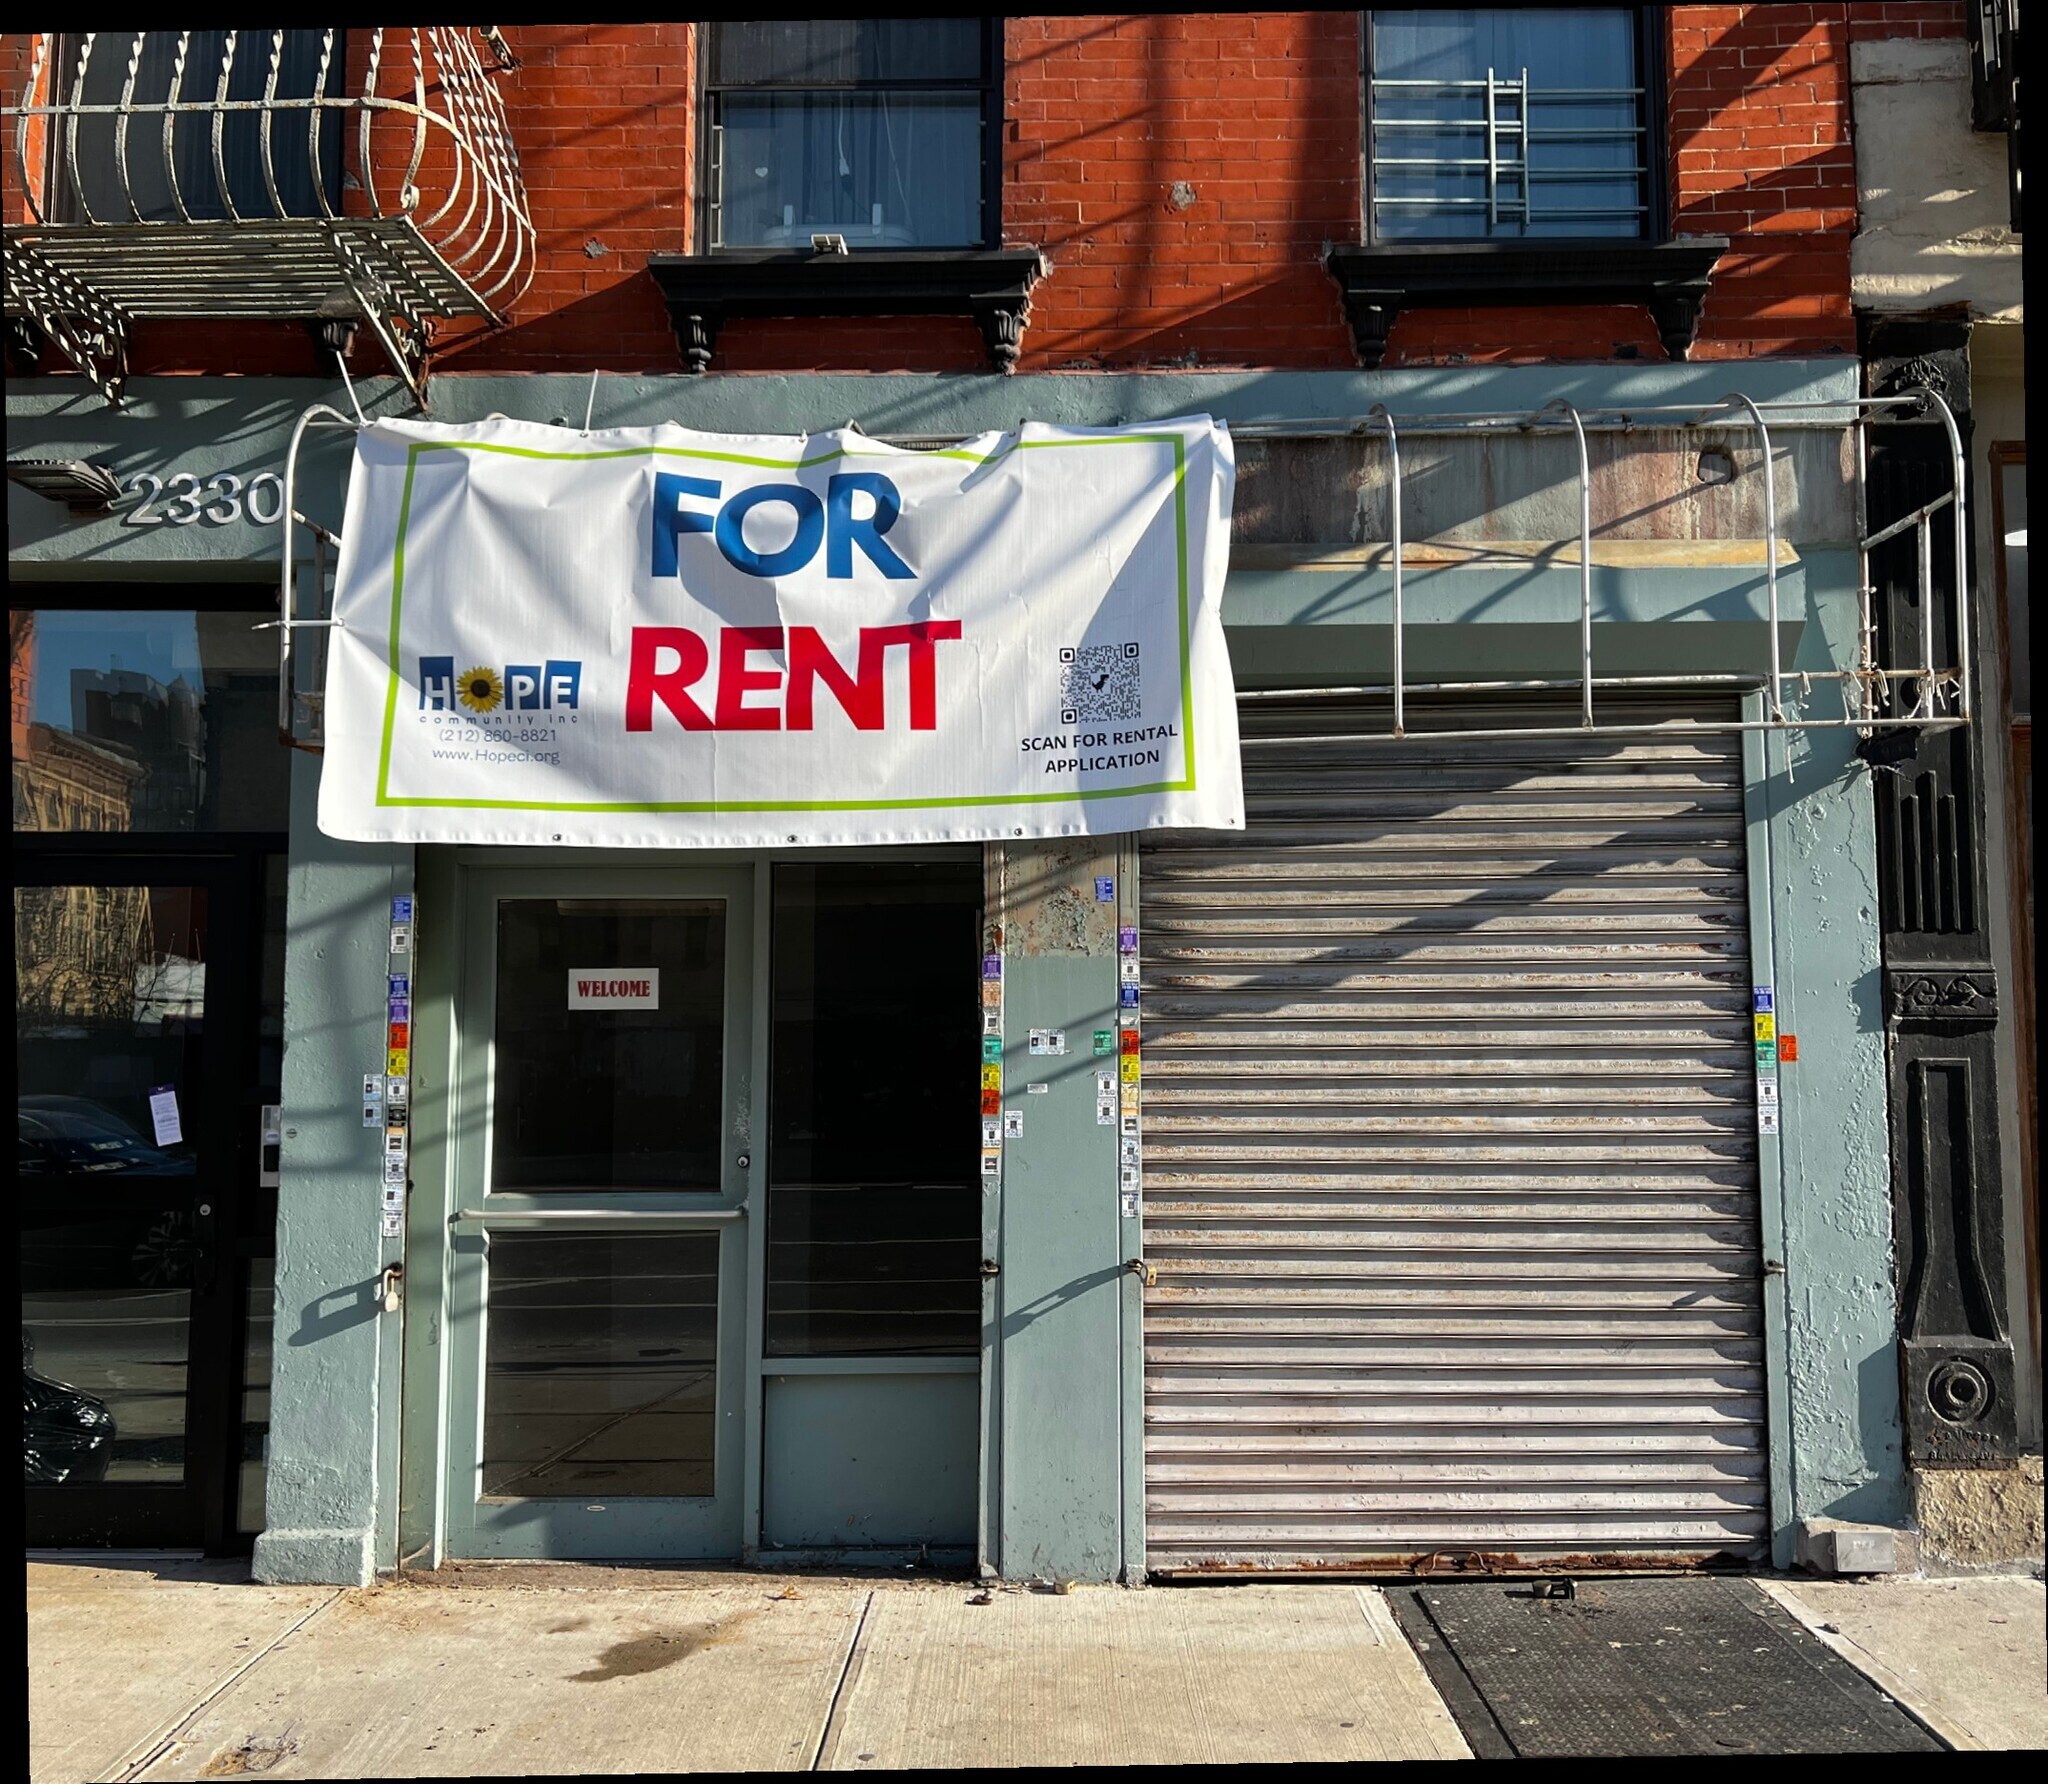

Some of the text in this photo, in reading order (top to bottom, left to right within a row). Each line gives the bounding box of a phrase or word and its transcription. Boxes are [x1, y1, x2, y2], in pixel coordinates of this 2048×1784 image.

[126, 472, 284, 525] 2330
[651, 471, 918, 579] FOR
[625, 619, 962, 732] RENT
[419, 714, 578, 725] community inc
[439, 729, 557, 743] (212) 860-8821
[1021, 723, 1178, 751] SCAN FOR RENTAL
[432, 748, 561, 766] www.Hopeci.org
[1045, 750, 1160, 774] APPLICATION
[577, 980, 651, 998] WELCOME
